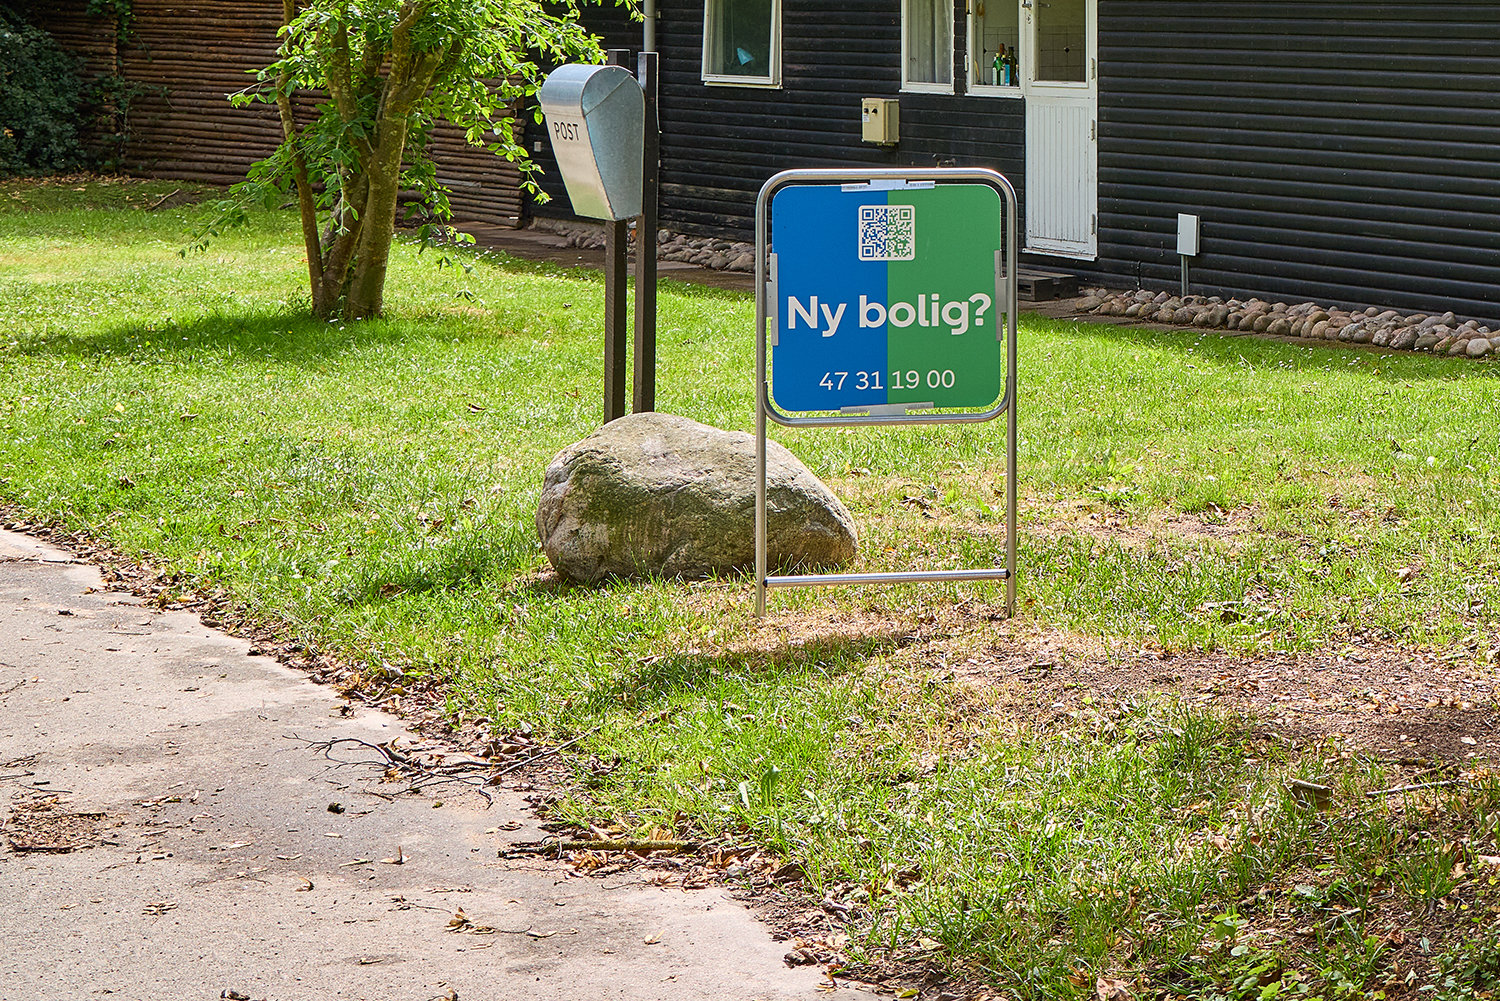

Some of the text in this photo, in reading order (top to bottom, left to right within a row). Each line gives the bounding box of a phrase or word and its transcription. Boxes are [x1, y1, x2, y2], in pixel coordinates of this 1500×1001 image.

[553, 121, 579, 140] POST
[788, 293, 992, 338] Ny bolig?
[819, 369, 955, 391] 47 31 19 00
